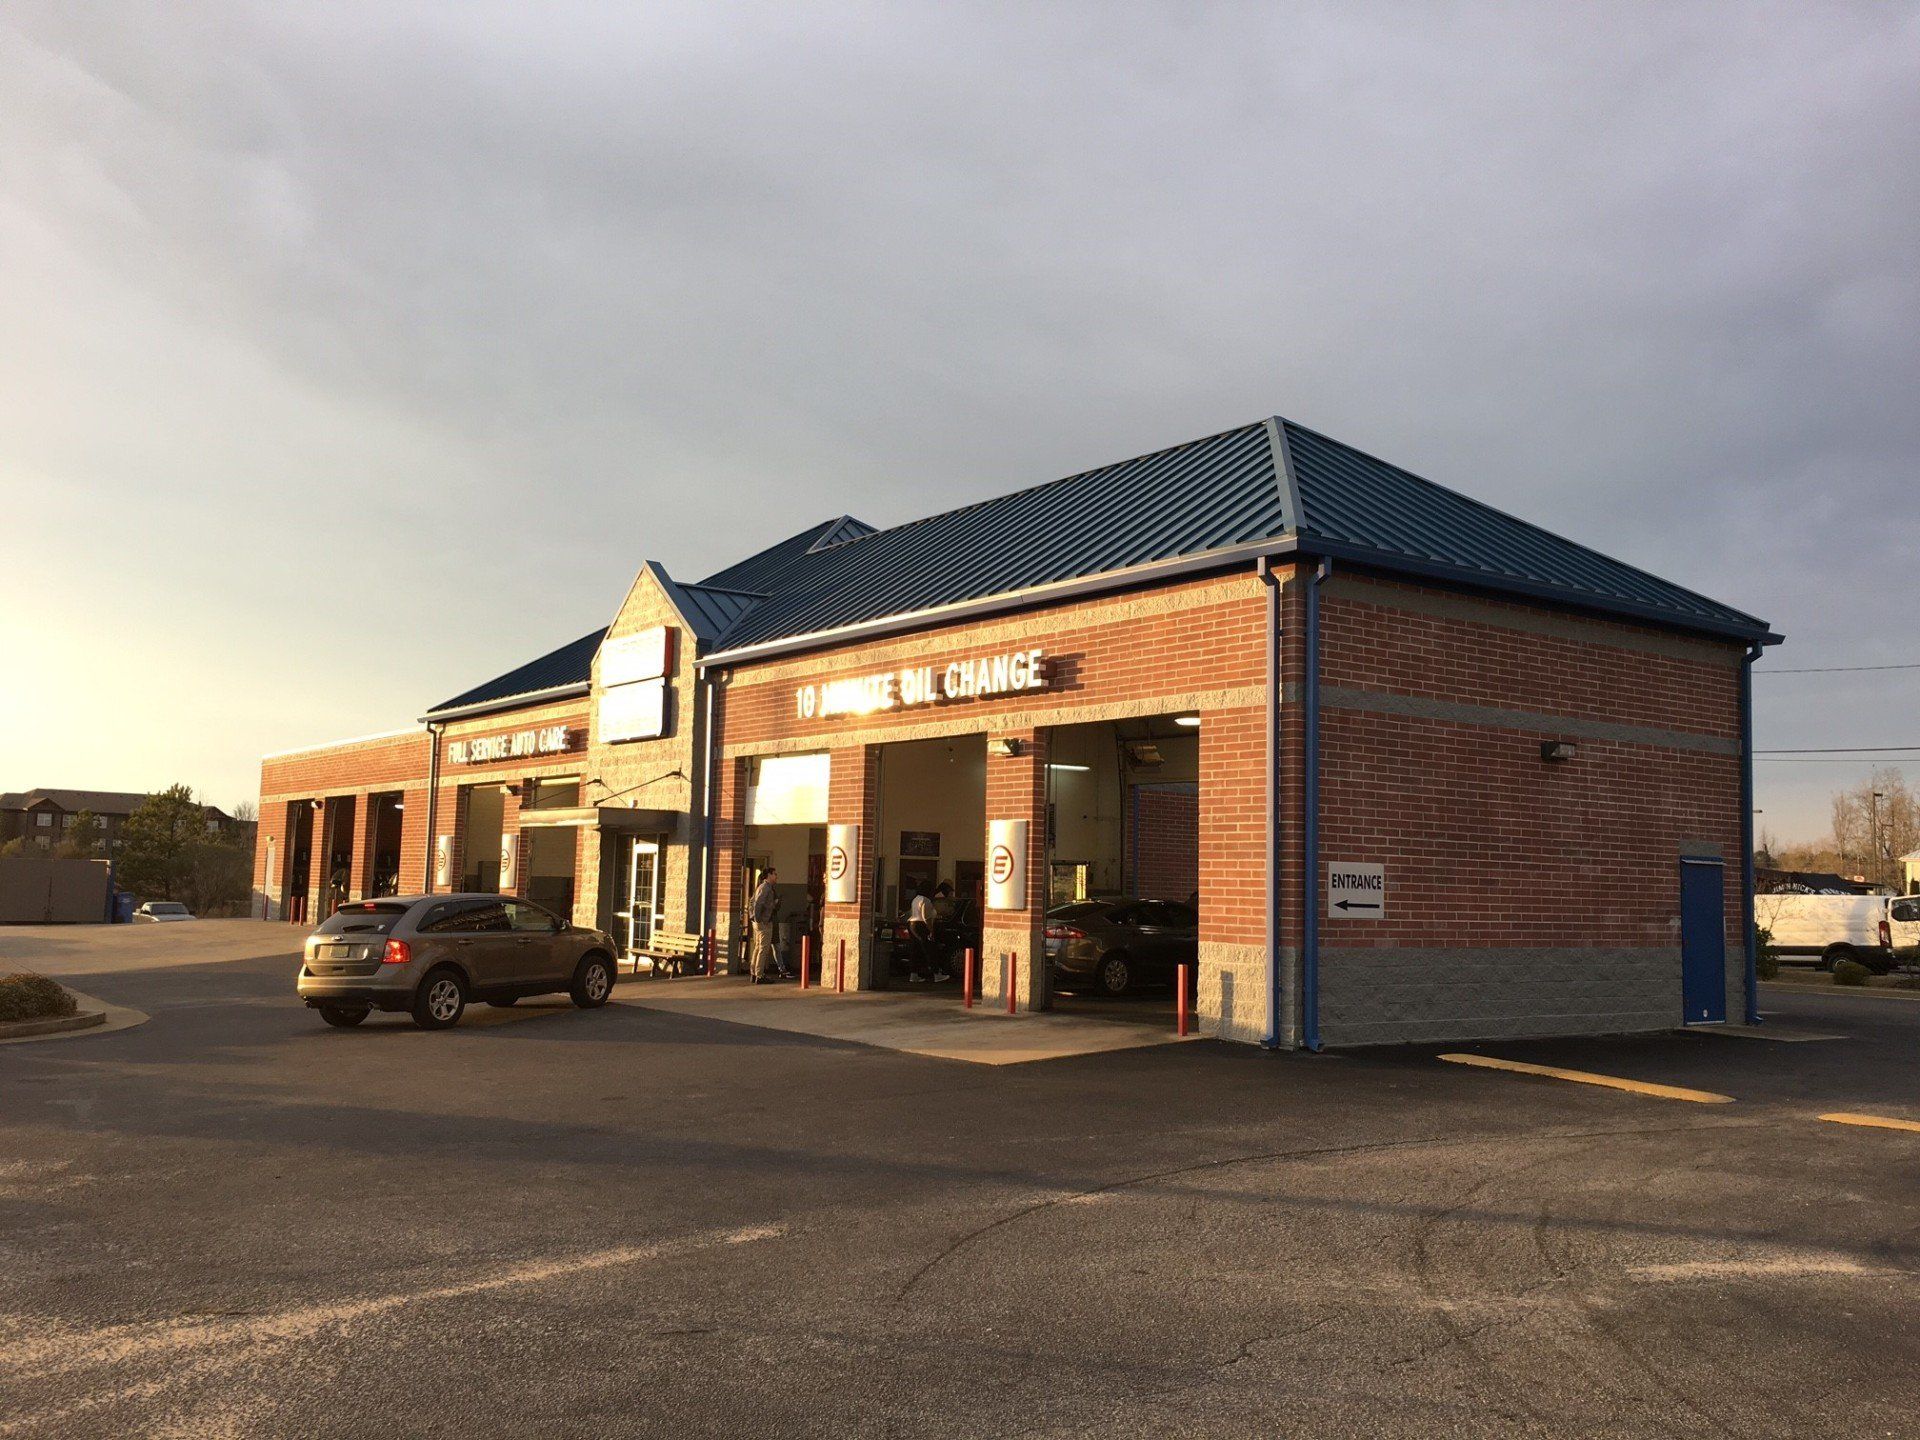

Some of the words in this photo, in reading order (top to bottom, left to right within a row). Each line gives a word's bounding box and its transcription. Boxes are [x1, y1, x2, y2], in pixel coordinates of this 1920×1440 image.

[796, 685, 815, 719] 10
[819, 673, 894, 717] MUTE
[900, 667, 937, 705] OIL
[944, 649, 1044, 699] CHANGE
[448, 741, 468, 764] FULL
[471, 735, 508, 761] SERVICE
[510, 730, 536, 756] AUTO
[539, 725, 568, 752] CARE
[1331, 873, 1382, 890] ENTRANCE
